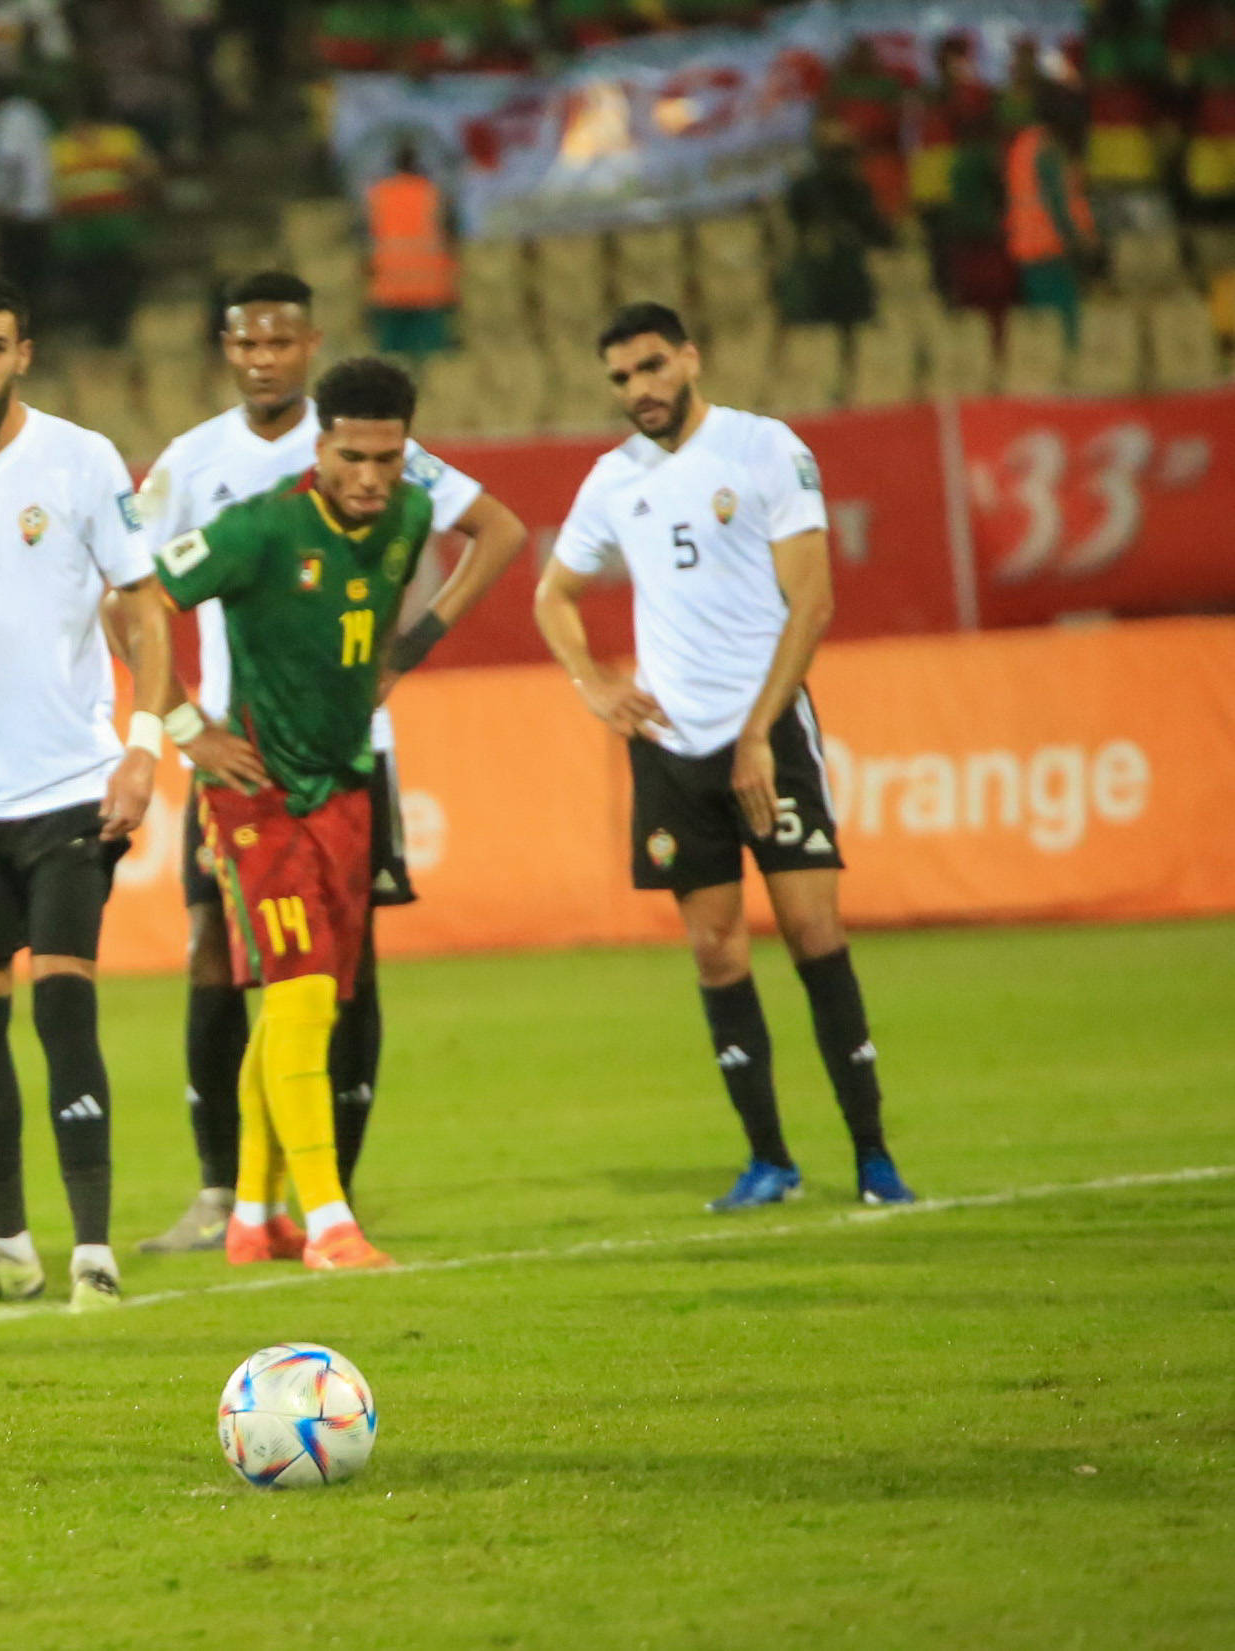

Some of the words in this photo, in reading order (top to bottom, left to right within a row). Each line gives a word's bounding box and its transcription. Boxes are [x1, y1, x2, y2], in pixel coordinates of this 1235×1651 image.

[673, 523, 699, 569] 5
[774, 797, 803, 845] 5
[259, 896, 311, 956] 14
